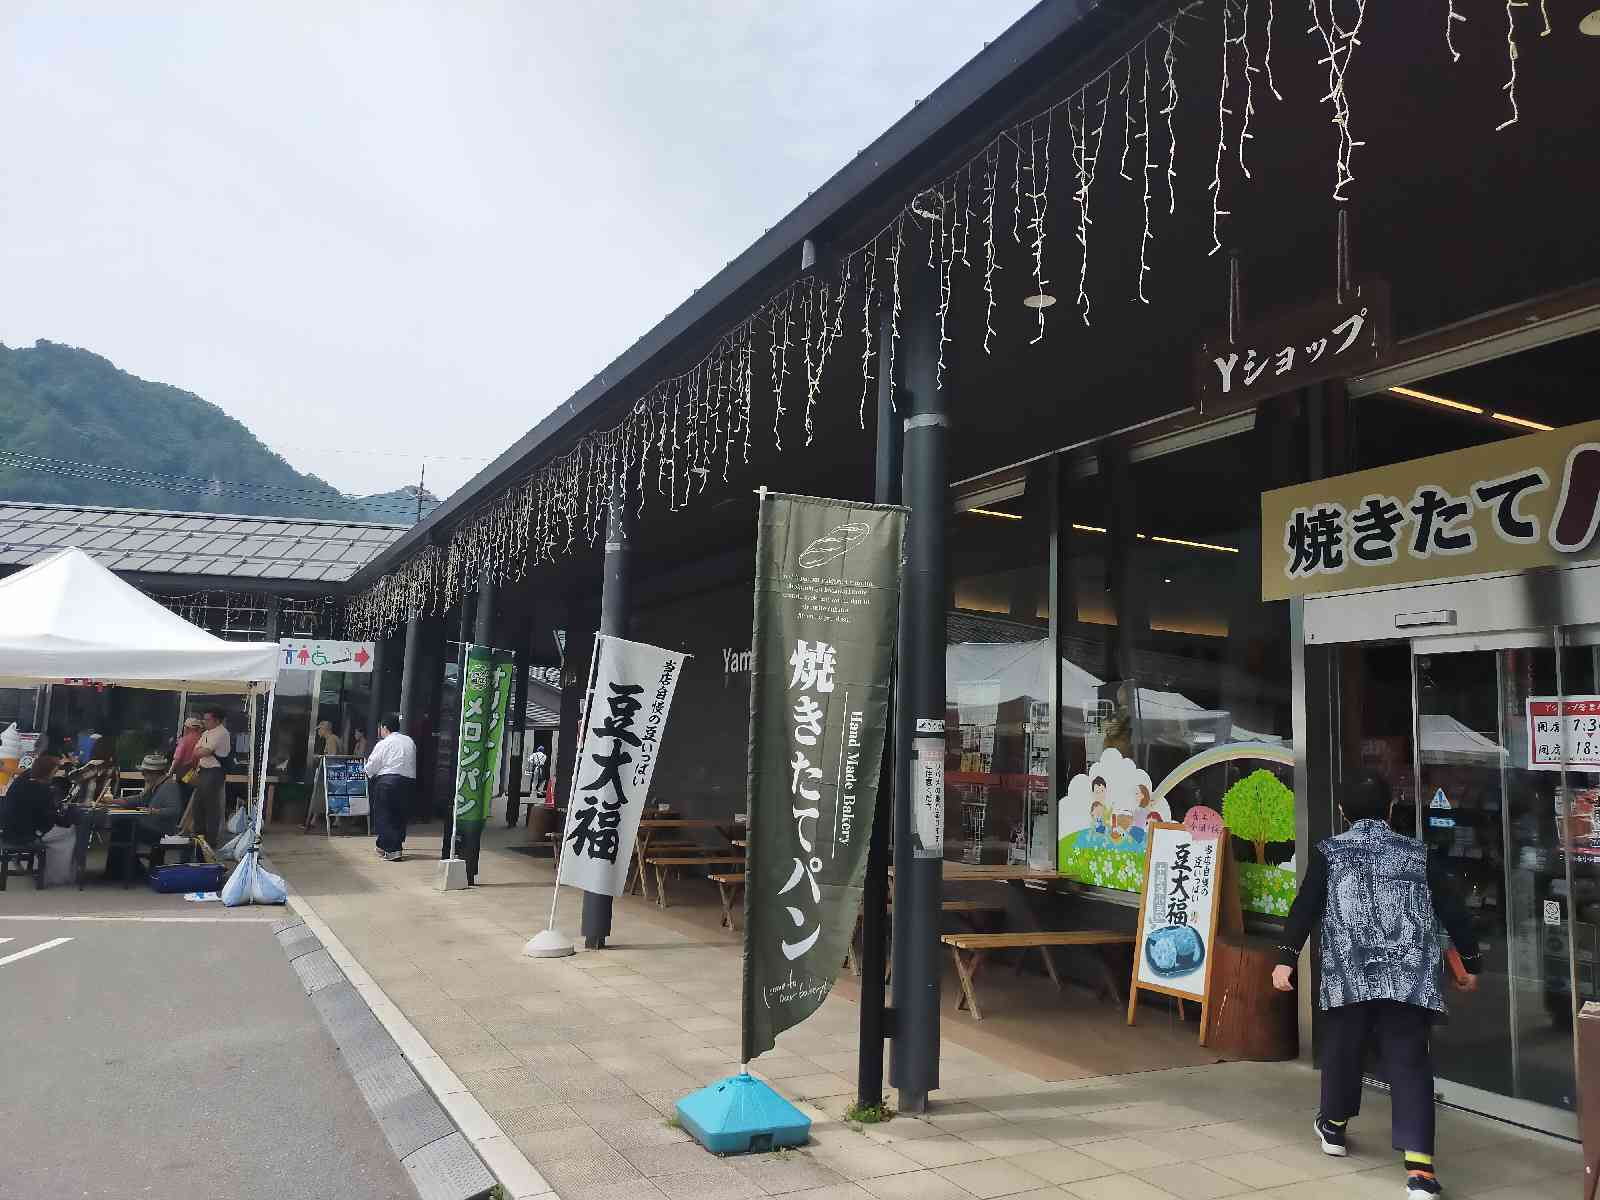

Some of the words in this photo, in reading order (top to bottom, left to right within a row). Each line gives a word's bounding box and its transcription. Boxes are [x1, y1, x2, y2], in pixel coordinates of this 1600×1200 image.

[1213, 307, 1369, 393] Yショップ
[454, 695, 483, 817] メロンパン
[847, 711, 863, 748] Hand
[1573, 718, 1600, 732] 7:3
[566, 681, 645, 865] 豆大福
[776, 638, 838, 961] 焼きたてパン
[844, 750, 860, 791] Made
[840, 792, 857, 847] Bakery
[1164, 843, 1193, 927] 豆大福
